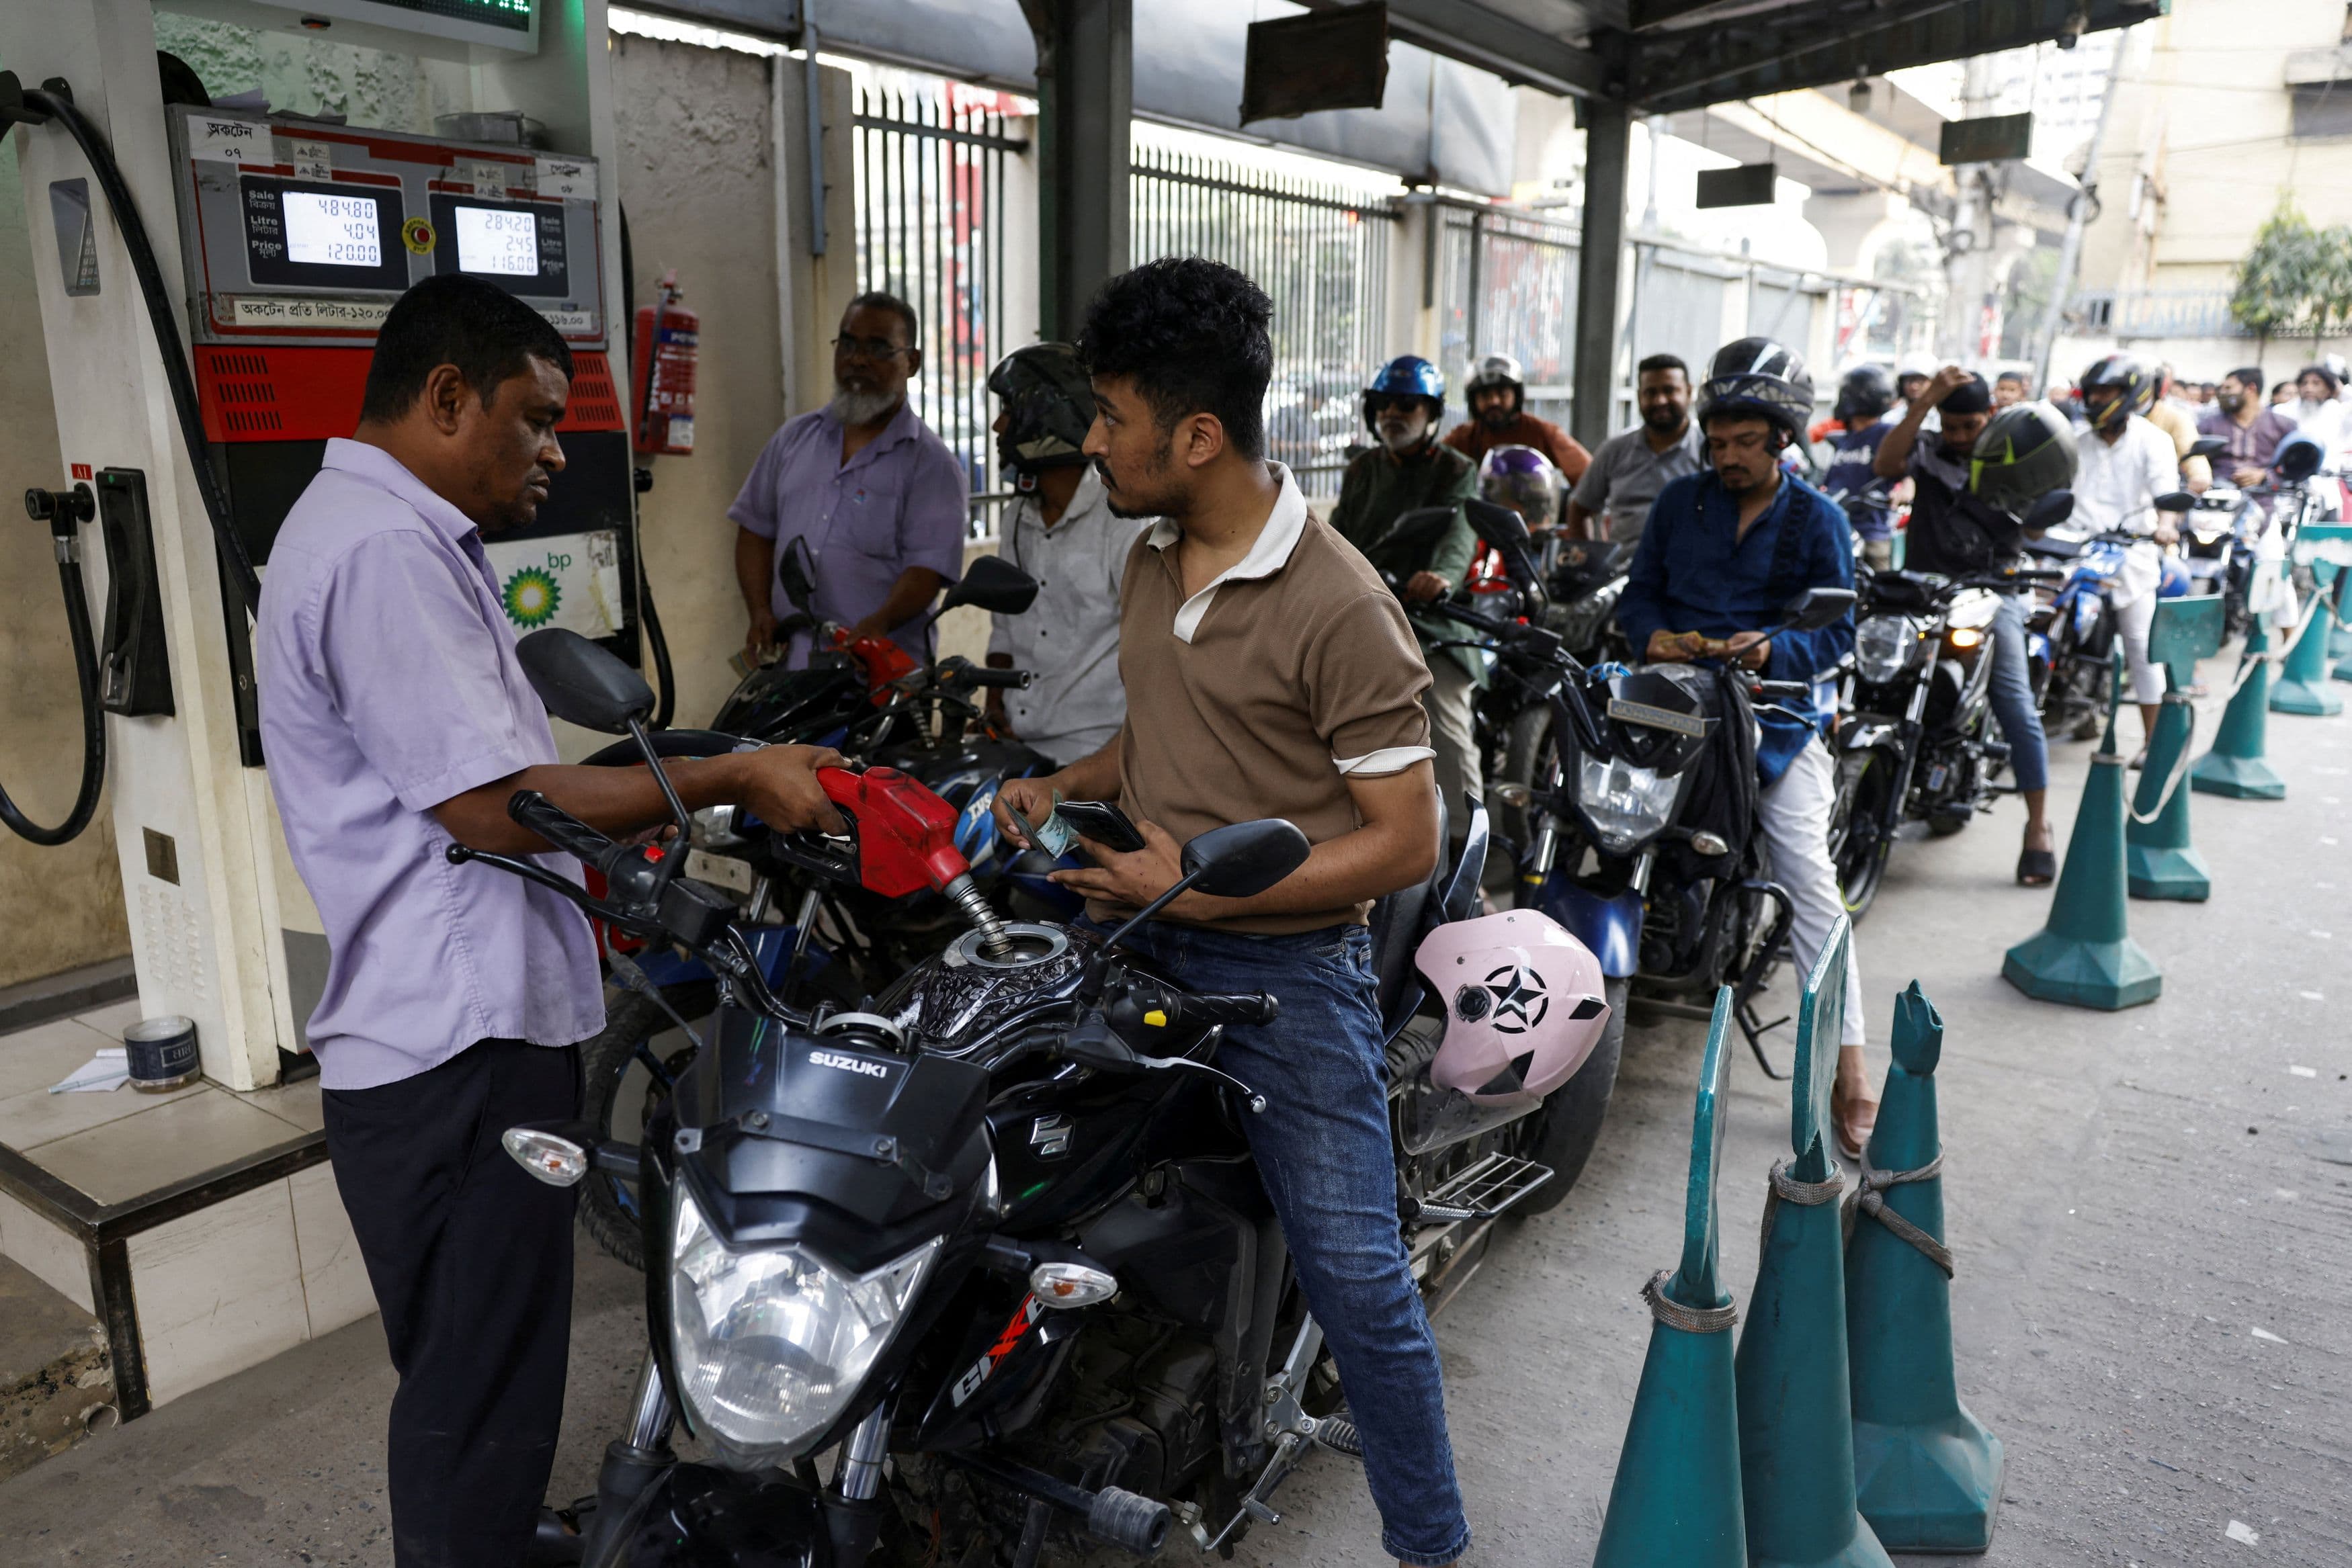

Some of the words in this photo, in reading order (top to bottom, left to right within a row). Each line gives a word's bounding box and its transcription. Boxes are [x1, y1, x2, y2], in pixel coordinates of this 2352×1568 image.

[207, 122, 253, 139] অকটেন
[225, 148, 241, 159] ০৭
[249, 190, 275, 200] Sale
[319, 199, 373, 219] 484.80
[251, 215, 278, 226] Litre
[485, 214, 532, 232] 284.20
[344, 223, 375, 240] 4.04
[252, 240, 282, 251] Price
[329, 243, 377, 262] 120.00
[506, 236, 533, 253] 2.45
[492, 256, 534, 271] 116.00
[241, 302, 285, 318] অকটেন
[289, 302, 311, 317] প্রতি
[548, 552, 572, 572] bp
[808, 1051, 888, 1078] SUZUKI
